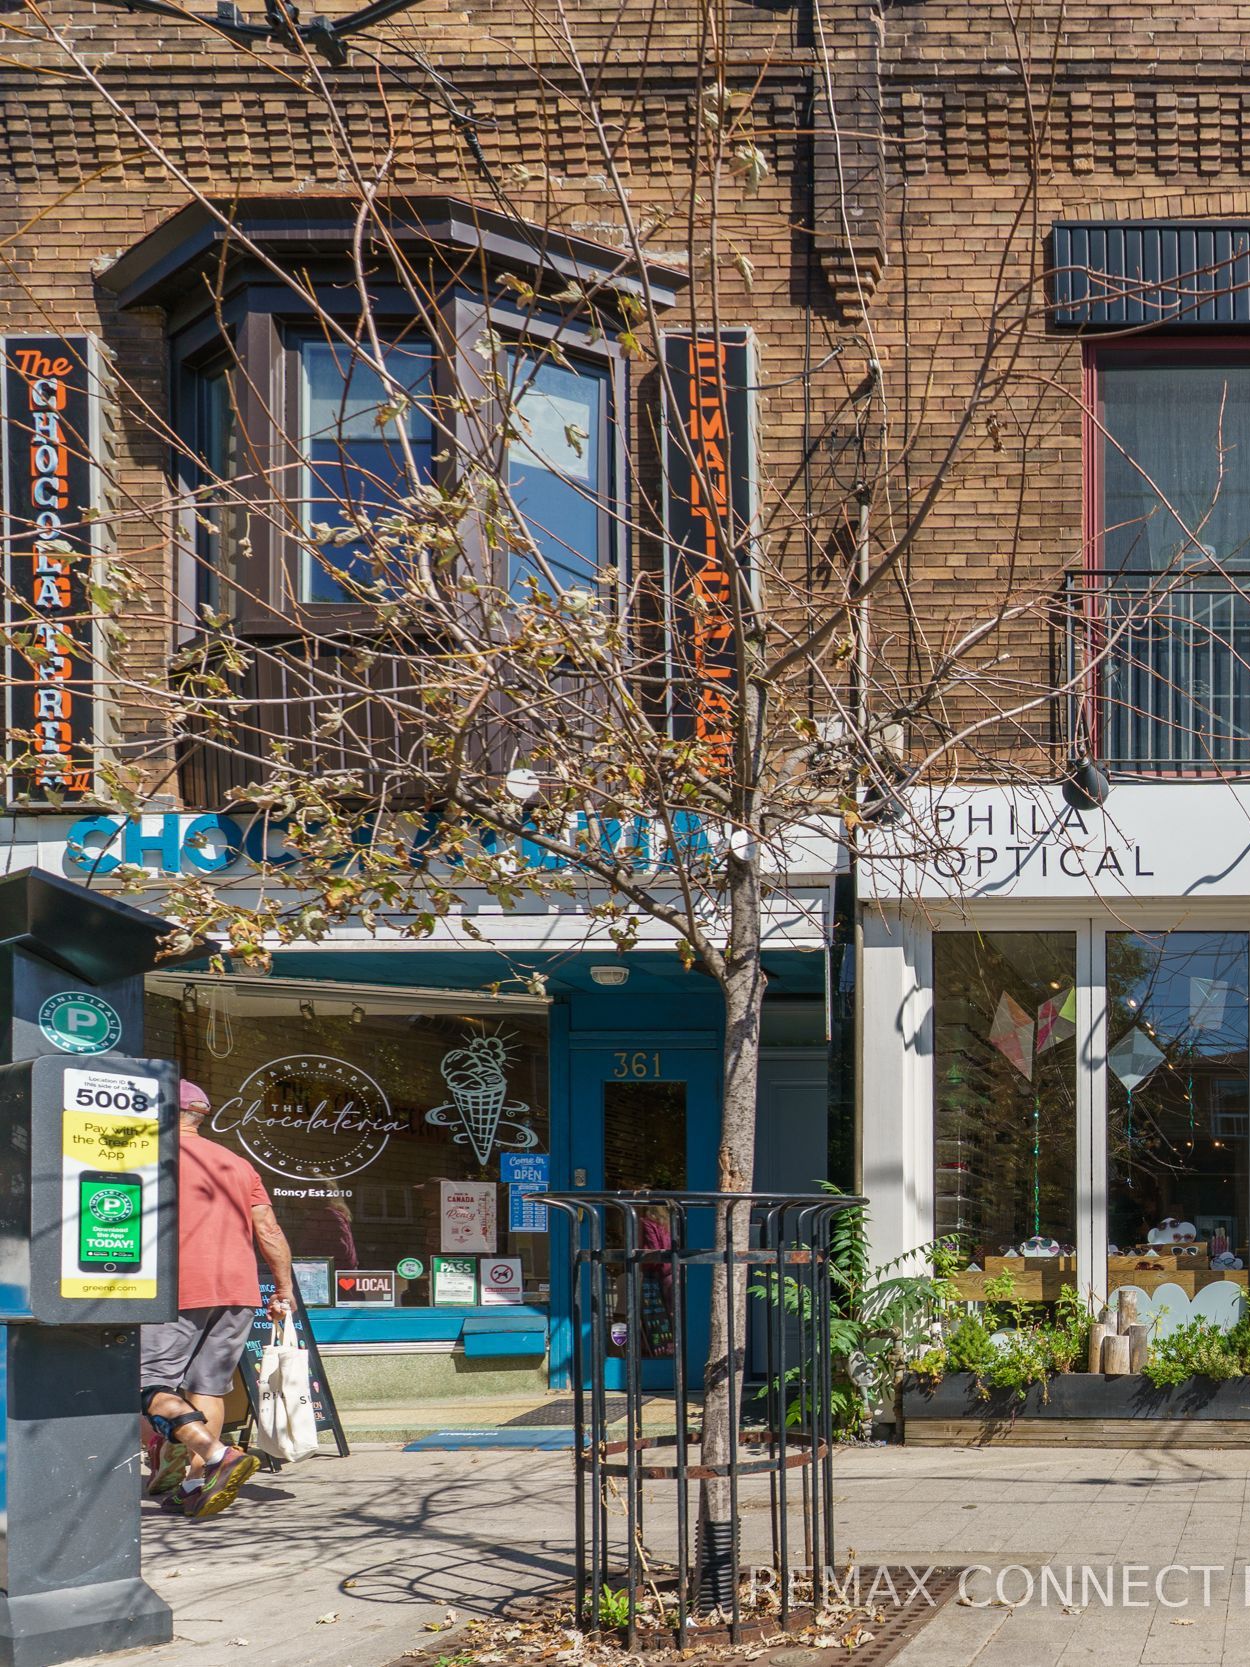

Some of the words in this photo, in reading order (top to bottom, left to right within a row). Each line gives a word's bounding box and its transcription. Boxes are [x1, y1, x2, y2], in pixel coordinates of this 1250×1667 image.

[16, 349, 74, 377] The
[935, 804, 1088, 836] PHILA
[933, 845, 1155, 878] OPTICAL
[43, 995, 117, 1025] MUNICIPAL
[613, 1052, 662, 1078] 361
[256, 1061, 370, 1092] HANDMADE
[75, 1088, 148, 1112] 5008
[211, 1096, 410, 1135] Chocolateria
[271, 1103, 304, 1113] THE
[84, 1122, 107, 1135] Pay
[112, 1125, 138, 1136] with
[73, 1134, 94, 1145] the
[98, 1137, 137, 1149] Green
[141, 1140, 149, 1149] P
[98, 1149, 125, 1160] App
[253, 1139, 374, 1173] CHOCOLATE
[509, 1157, 535, 1166] Come
[514, 1169, 542, 1180] OPEN
[273, 1187, 307, 1199] Roncy
[308, 1188, 325, 1197] Est
[326, 1188, 353, 1198] 2010
[86, 1238, 134, 1249] TODAY!
[440, 1262, 471, 1273] PASS
[356, 1278, 391, 1291] LOCAL
